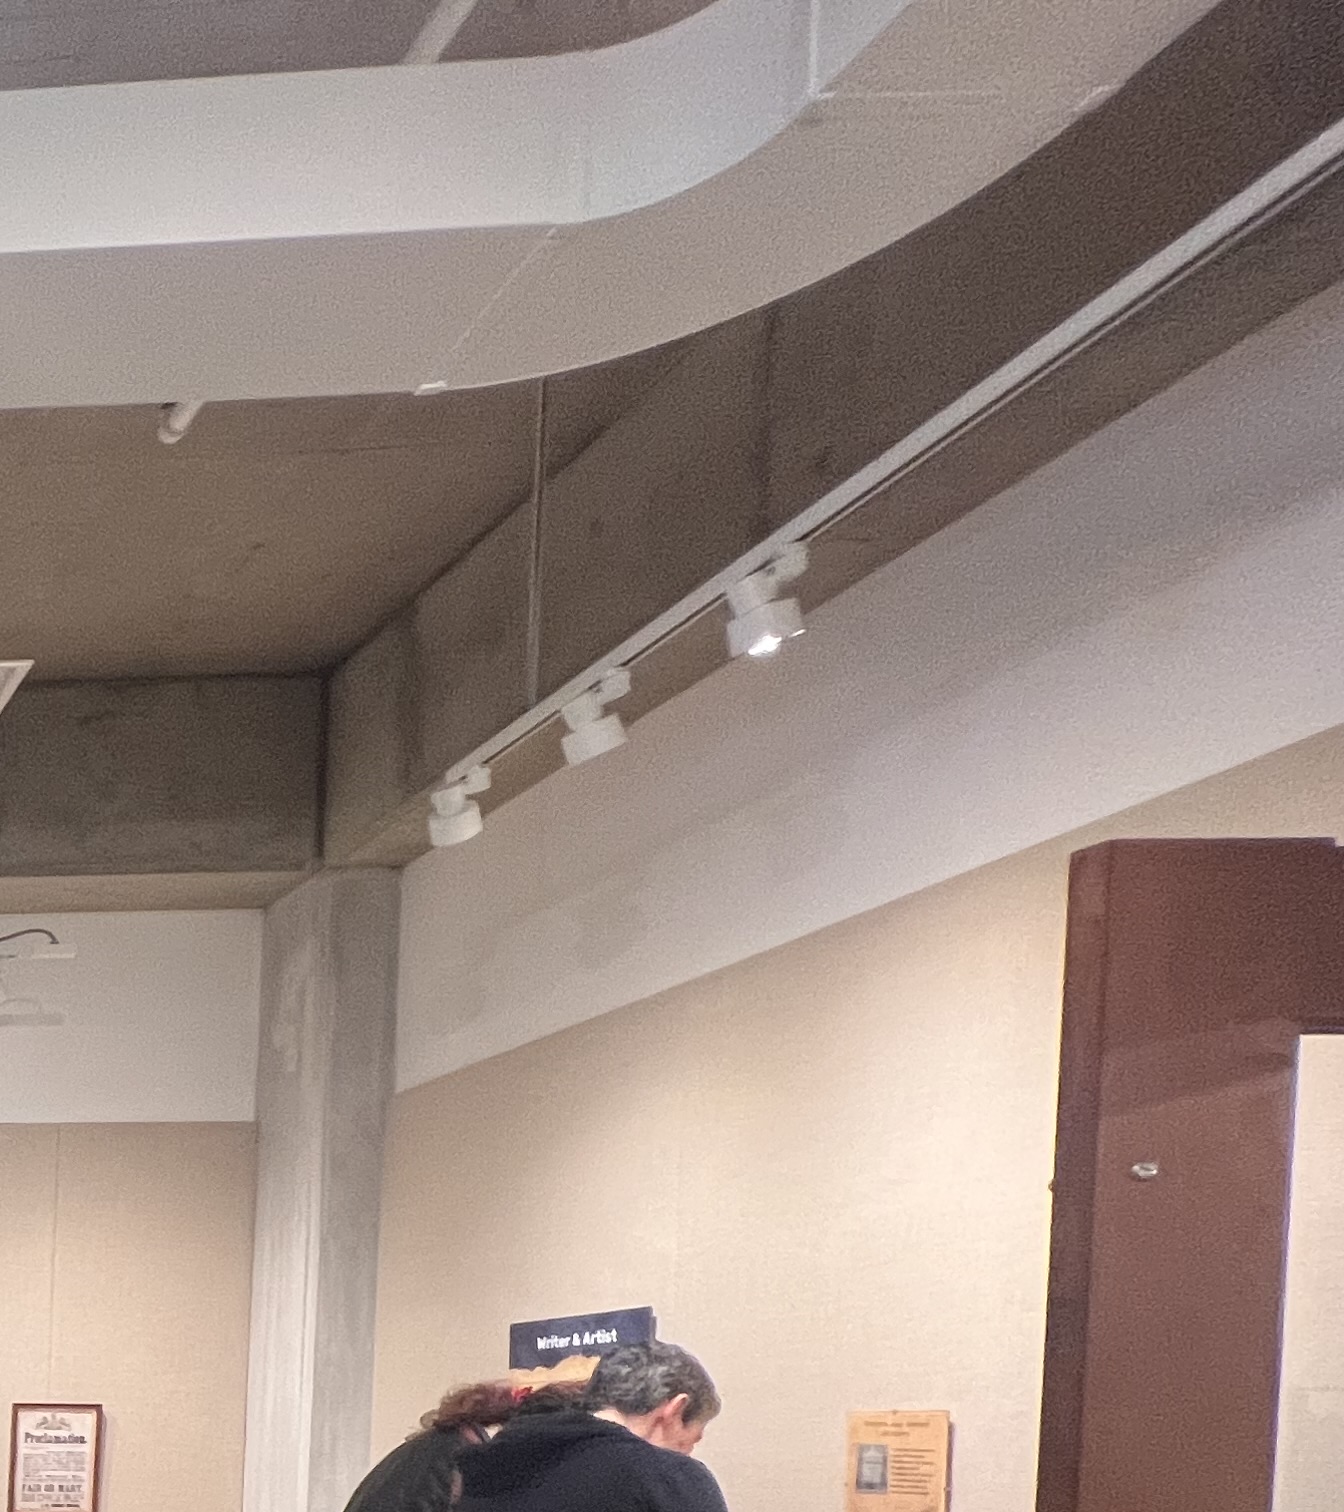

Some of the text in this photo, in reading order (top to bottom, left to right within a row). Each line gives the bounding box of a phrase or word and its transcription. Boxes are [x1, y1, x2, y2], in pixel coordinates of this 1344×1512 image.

[536, 1328, 618, 1350] Writer & Artist
